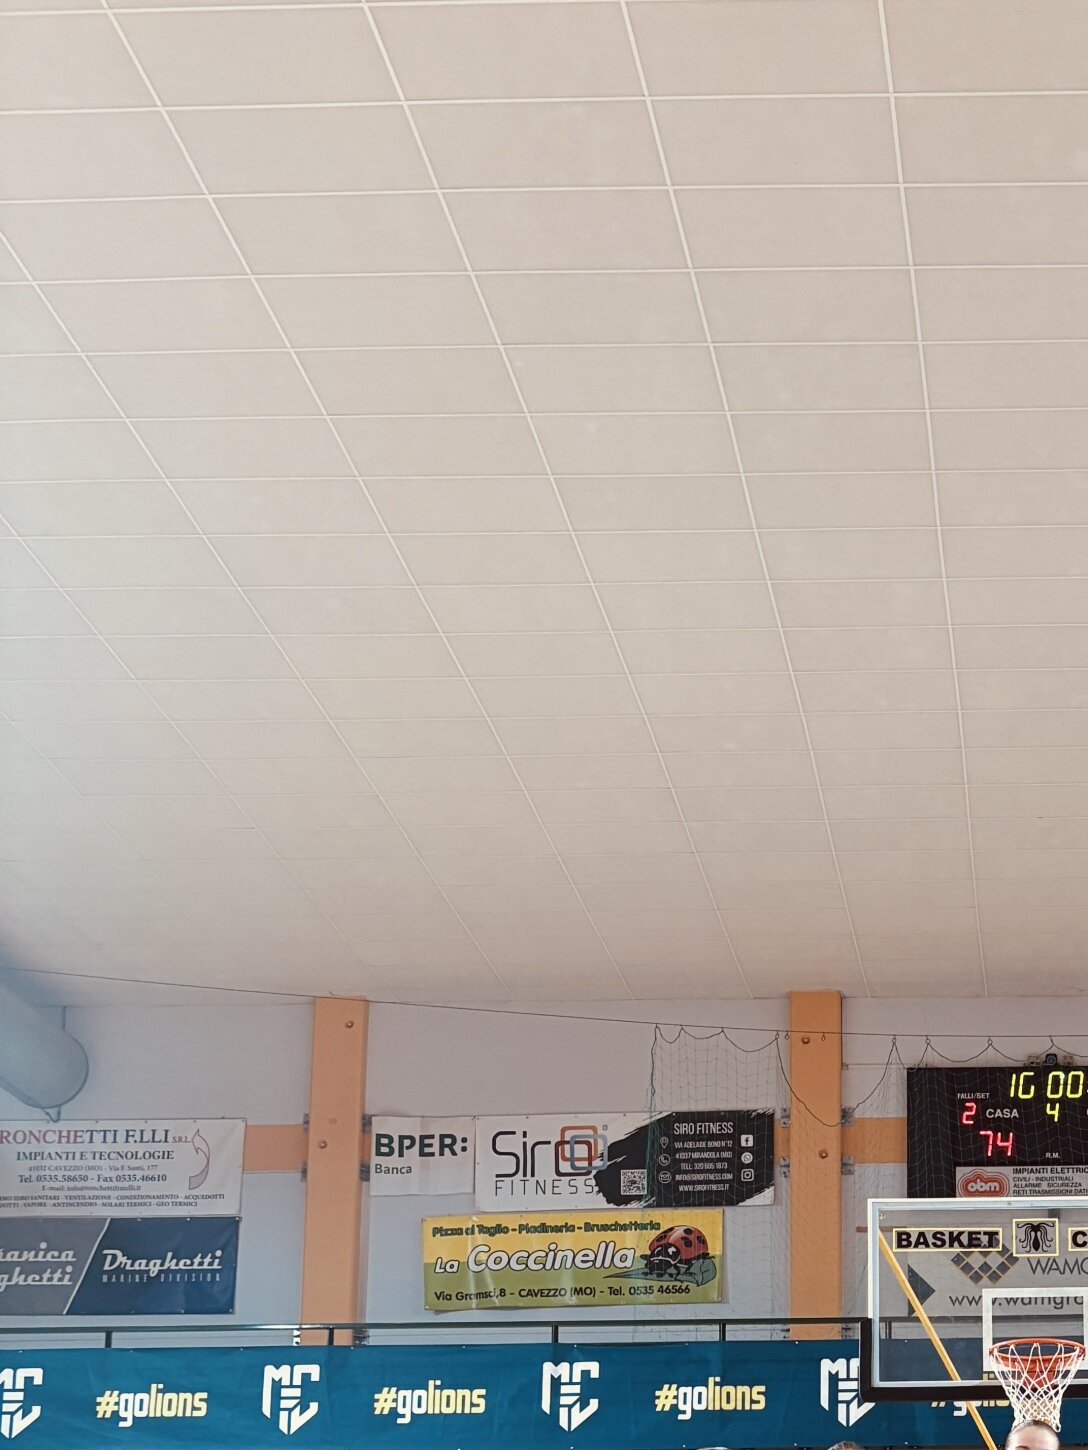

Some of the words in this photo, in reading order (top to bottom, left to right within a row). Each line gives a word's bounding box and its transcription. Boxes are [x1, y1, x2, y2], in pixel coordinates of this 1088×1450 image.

[957, 1092, 991, 1100] FALLI/SET
[962, 1102, 977, 1125] 2
[986, 1108, 1020, 1119] CASA
[1046, 1102, 1060, 1122] 4
[673, 1122, 695, 1135] SIRO
[696, 1121, 734, 1134] FITNESS
[0, 1129, 119, 1145] RONCHETTI
[124, 1129, 170, 1144] F.LLI
[979, 1130, 1014, 1157] 74
[16, 1151, 76, 1161] IMPIANTI
[80, 1151, 88, 1161] E
[91, 1150, 175, 1160] TECNOLOGIE
[374, 1163, 413, 1175] Banca
[1012, 1167, 1048, 1175] IMPIANTI
[36, 1174, 89, 1183] 0535.58650
[97, 1174, 114, 1183] Fax
[495, 1178, 595, 1196] FITNESS
[432, 1226, 463, 1237] Pizza
[476, 1223, 510, 1237] Taglio
[518, 1222, 576, 1235] Piadineria
[583, 1220, 661, 1233] Bruschetteria
[896, 1231, 999, 1249] BASKET
[102, 1249, 223, 1277] Draghetti
[434, 1256, 460, 1273] La
[466, 1240, 636, 1273] Coccinella
[434, 1291, 452, 1301] Via
[518, 1287, 567, 1299] CAVEZZO
[570, 1286, 596, 1298] (MO)
[607, 1286, 626, 1296] Tel.
[628, 1285, 655, 1296] 0535
[656, 1284, 691, 1295] 46566
[96, 1382, 208, 1428] #golions
[374, 1379, 486, 1424] #golions
[654, 1376, 766, 1421] #golions
